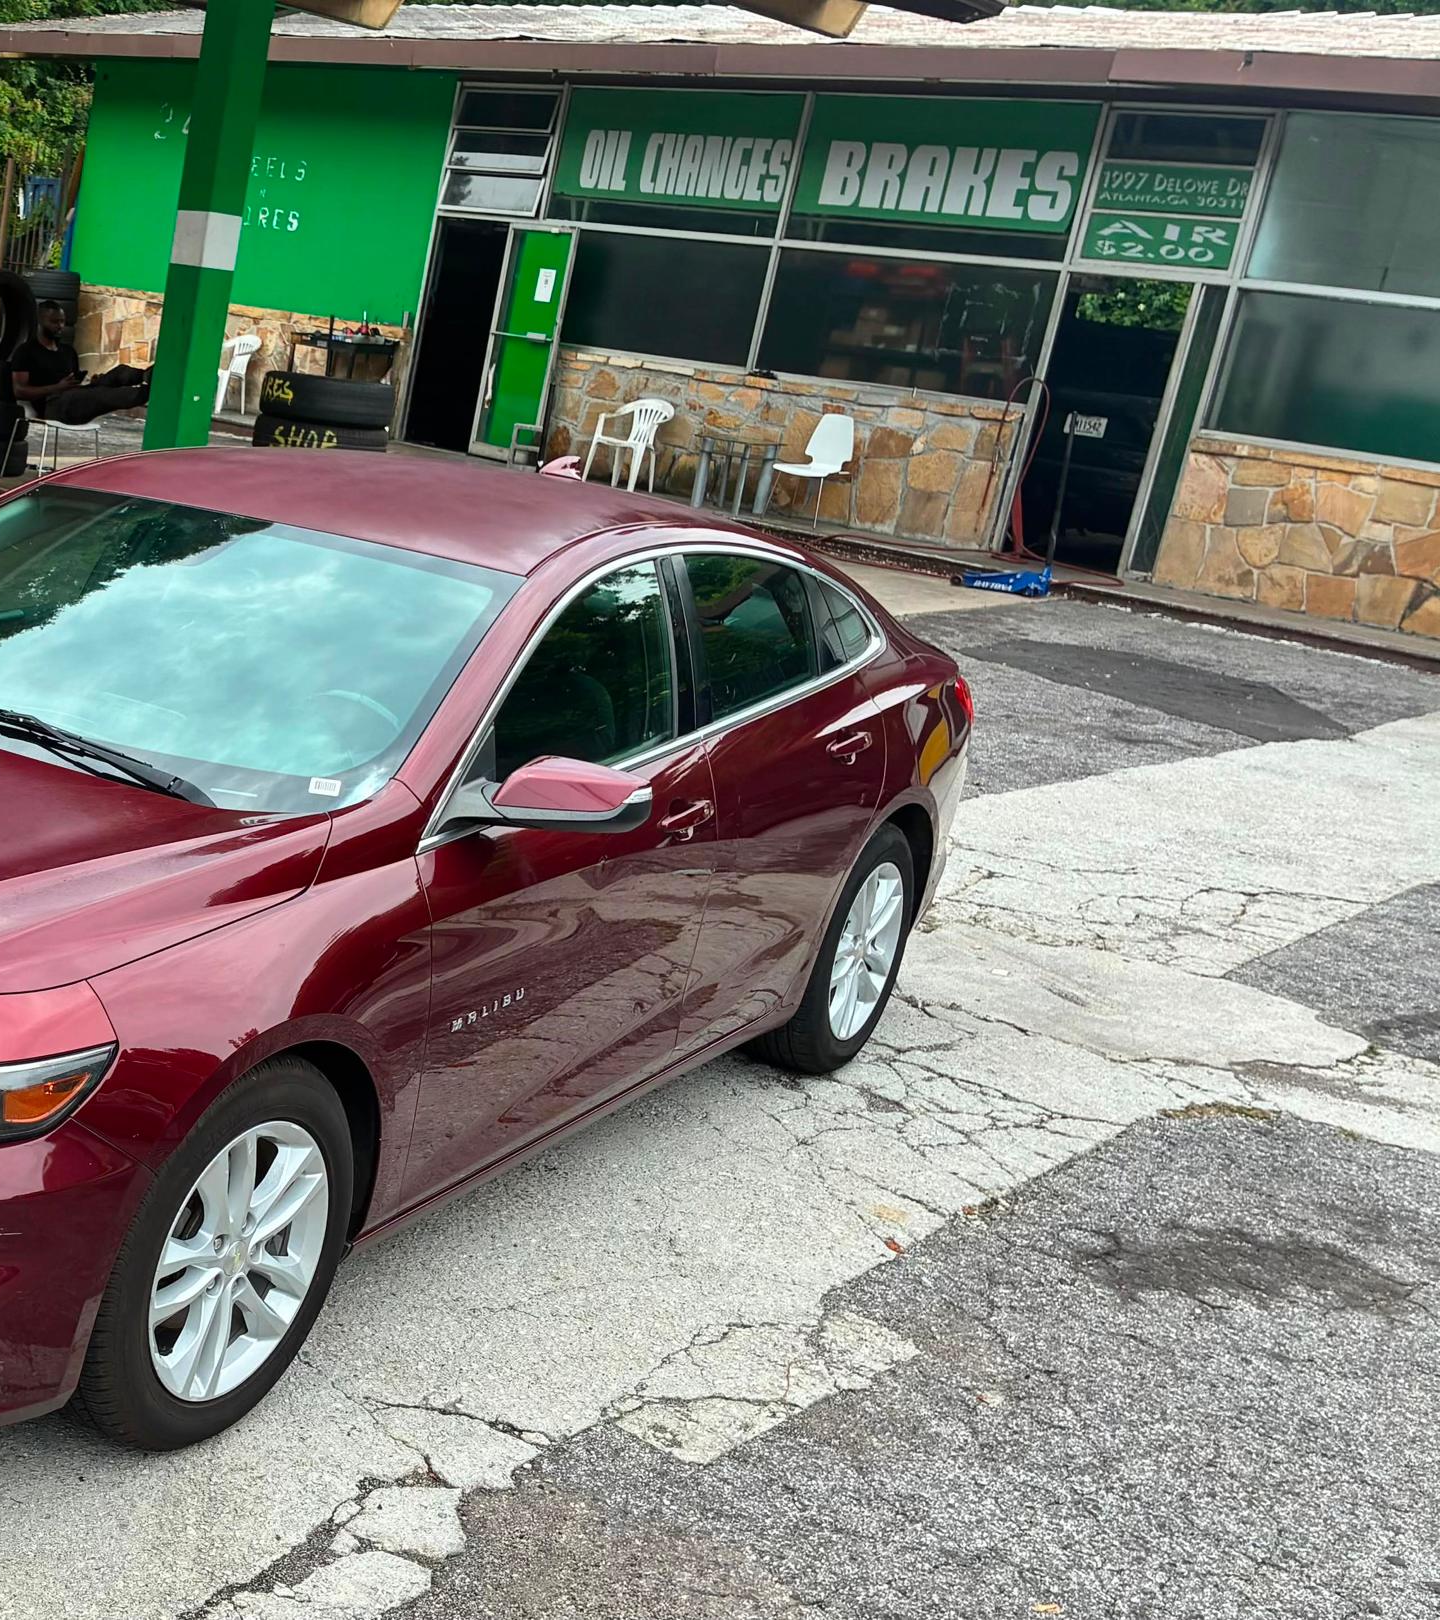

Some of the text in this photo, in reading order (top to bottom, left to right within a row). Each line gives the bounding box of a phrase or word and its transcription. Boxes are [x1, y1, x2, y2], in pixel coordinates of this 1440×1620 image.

[579, 129, 793, 203] OIL CHANGES
[818, 140, 1079, 223] BRAKES
[1103, 170, 1149, 190] 1997
[1096, 219, 1231, 246] AIR
[1094, 240, 1215, 263] $2.00
[272, 424, 338, 449] SHOP
[450, 987, 525, 1033] MALIBU
